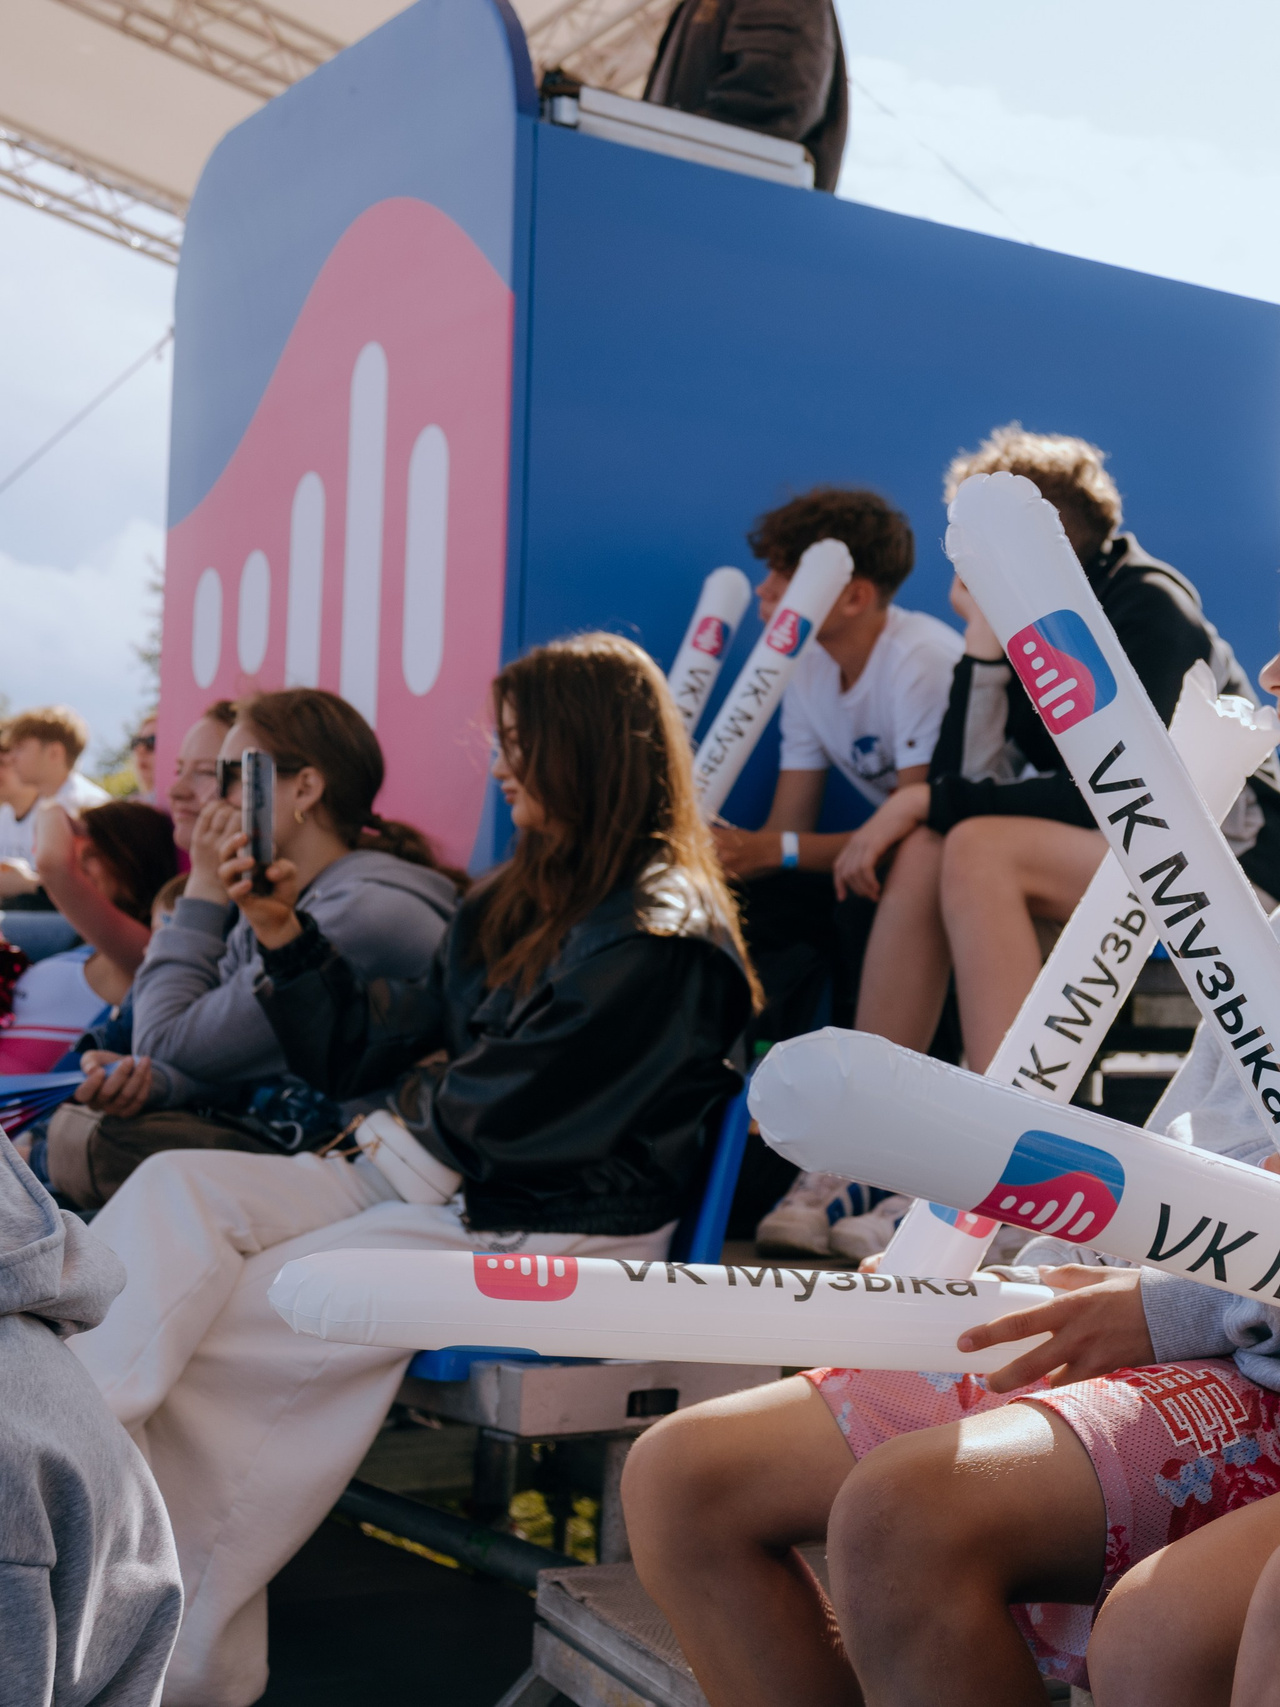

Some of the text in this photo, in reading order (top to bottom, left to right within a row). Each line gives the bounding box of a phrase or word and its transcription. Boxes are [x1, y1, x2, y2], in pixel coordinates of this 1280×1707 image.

[680, 668, 712, 704] VK
[695, 667, 780, 794] VK Музы
[1087, 739, 1170, 856] VK
[1011, 891, 1148, 1092] K Музы
[613, 1258, 979, 1303] VK Музыка
[1145, 1202, 1260, 1284] VK
